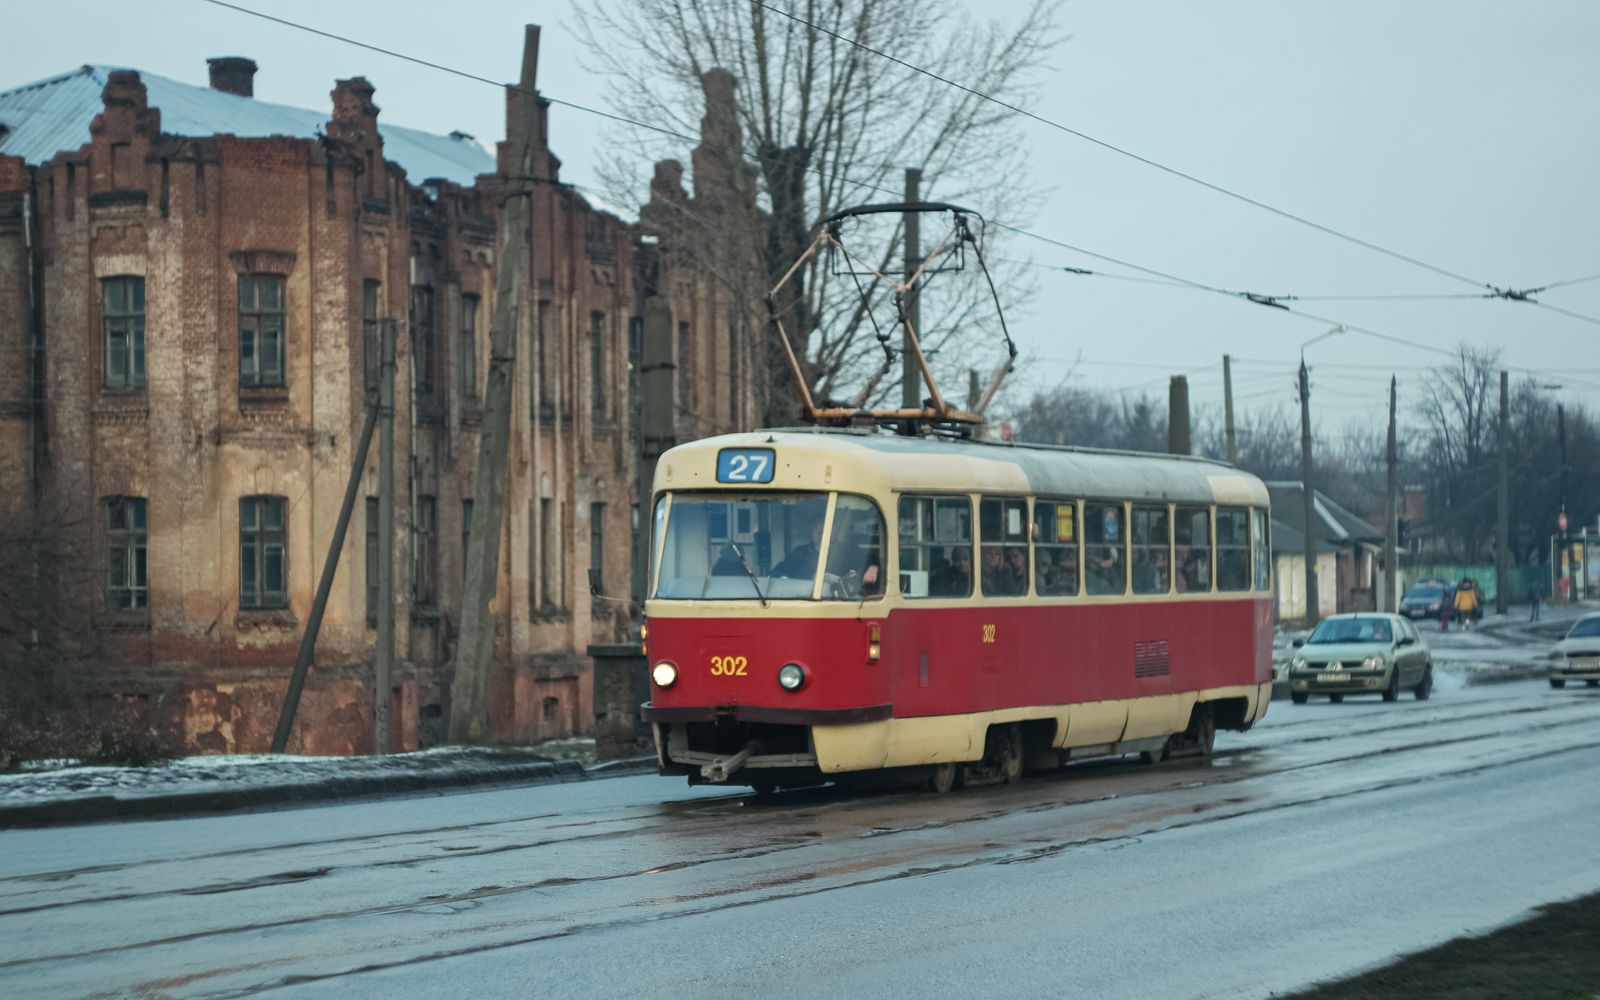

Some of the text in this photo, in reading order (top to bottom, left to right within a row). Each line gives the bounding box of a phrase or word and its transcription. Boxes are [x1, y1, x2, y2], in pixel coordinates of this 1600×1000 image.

[728, 455, 768, 481] 27
[983, 624, 996, 643] 302
[710, 656, 748, 676] 302
